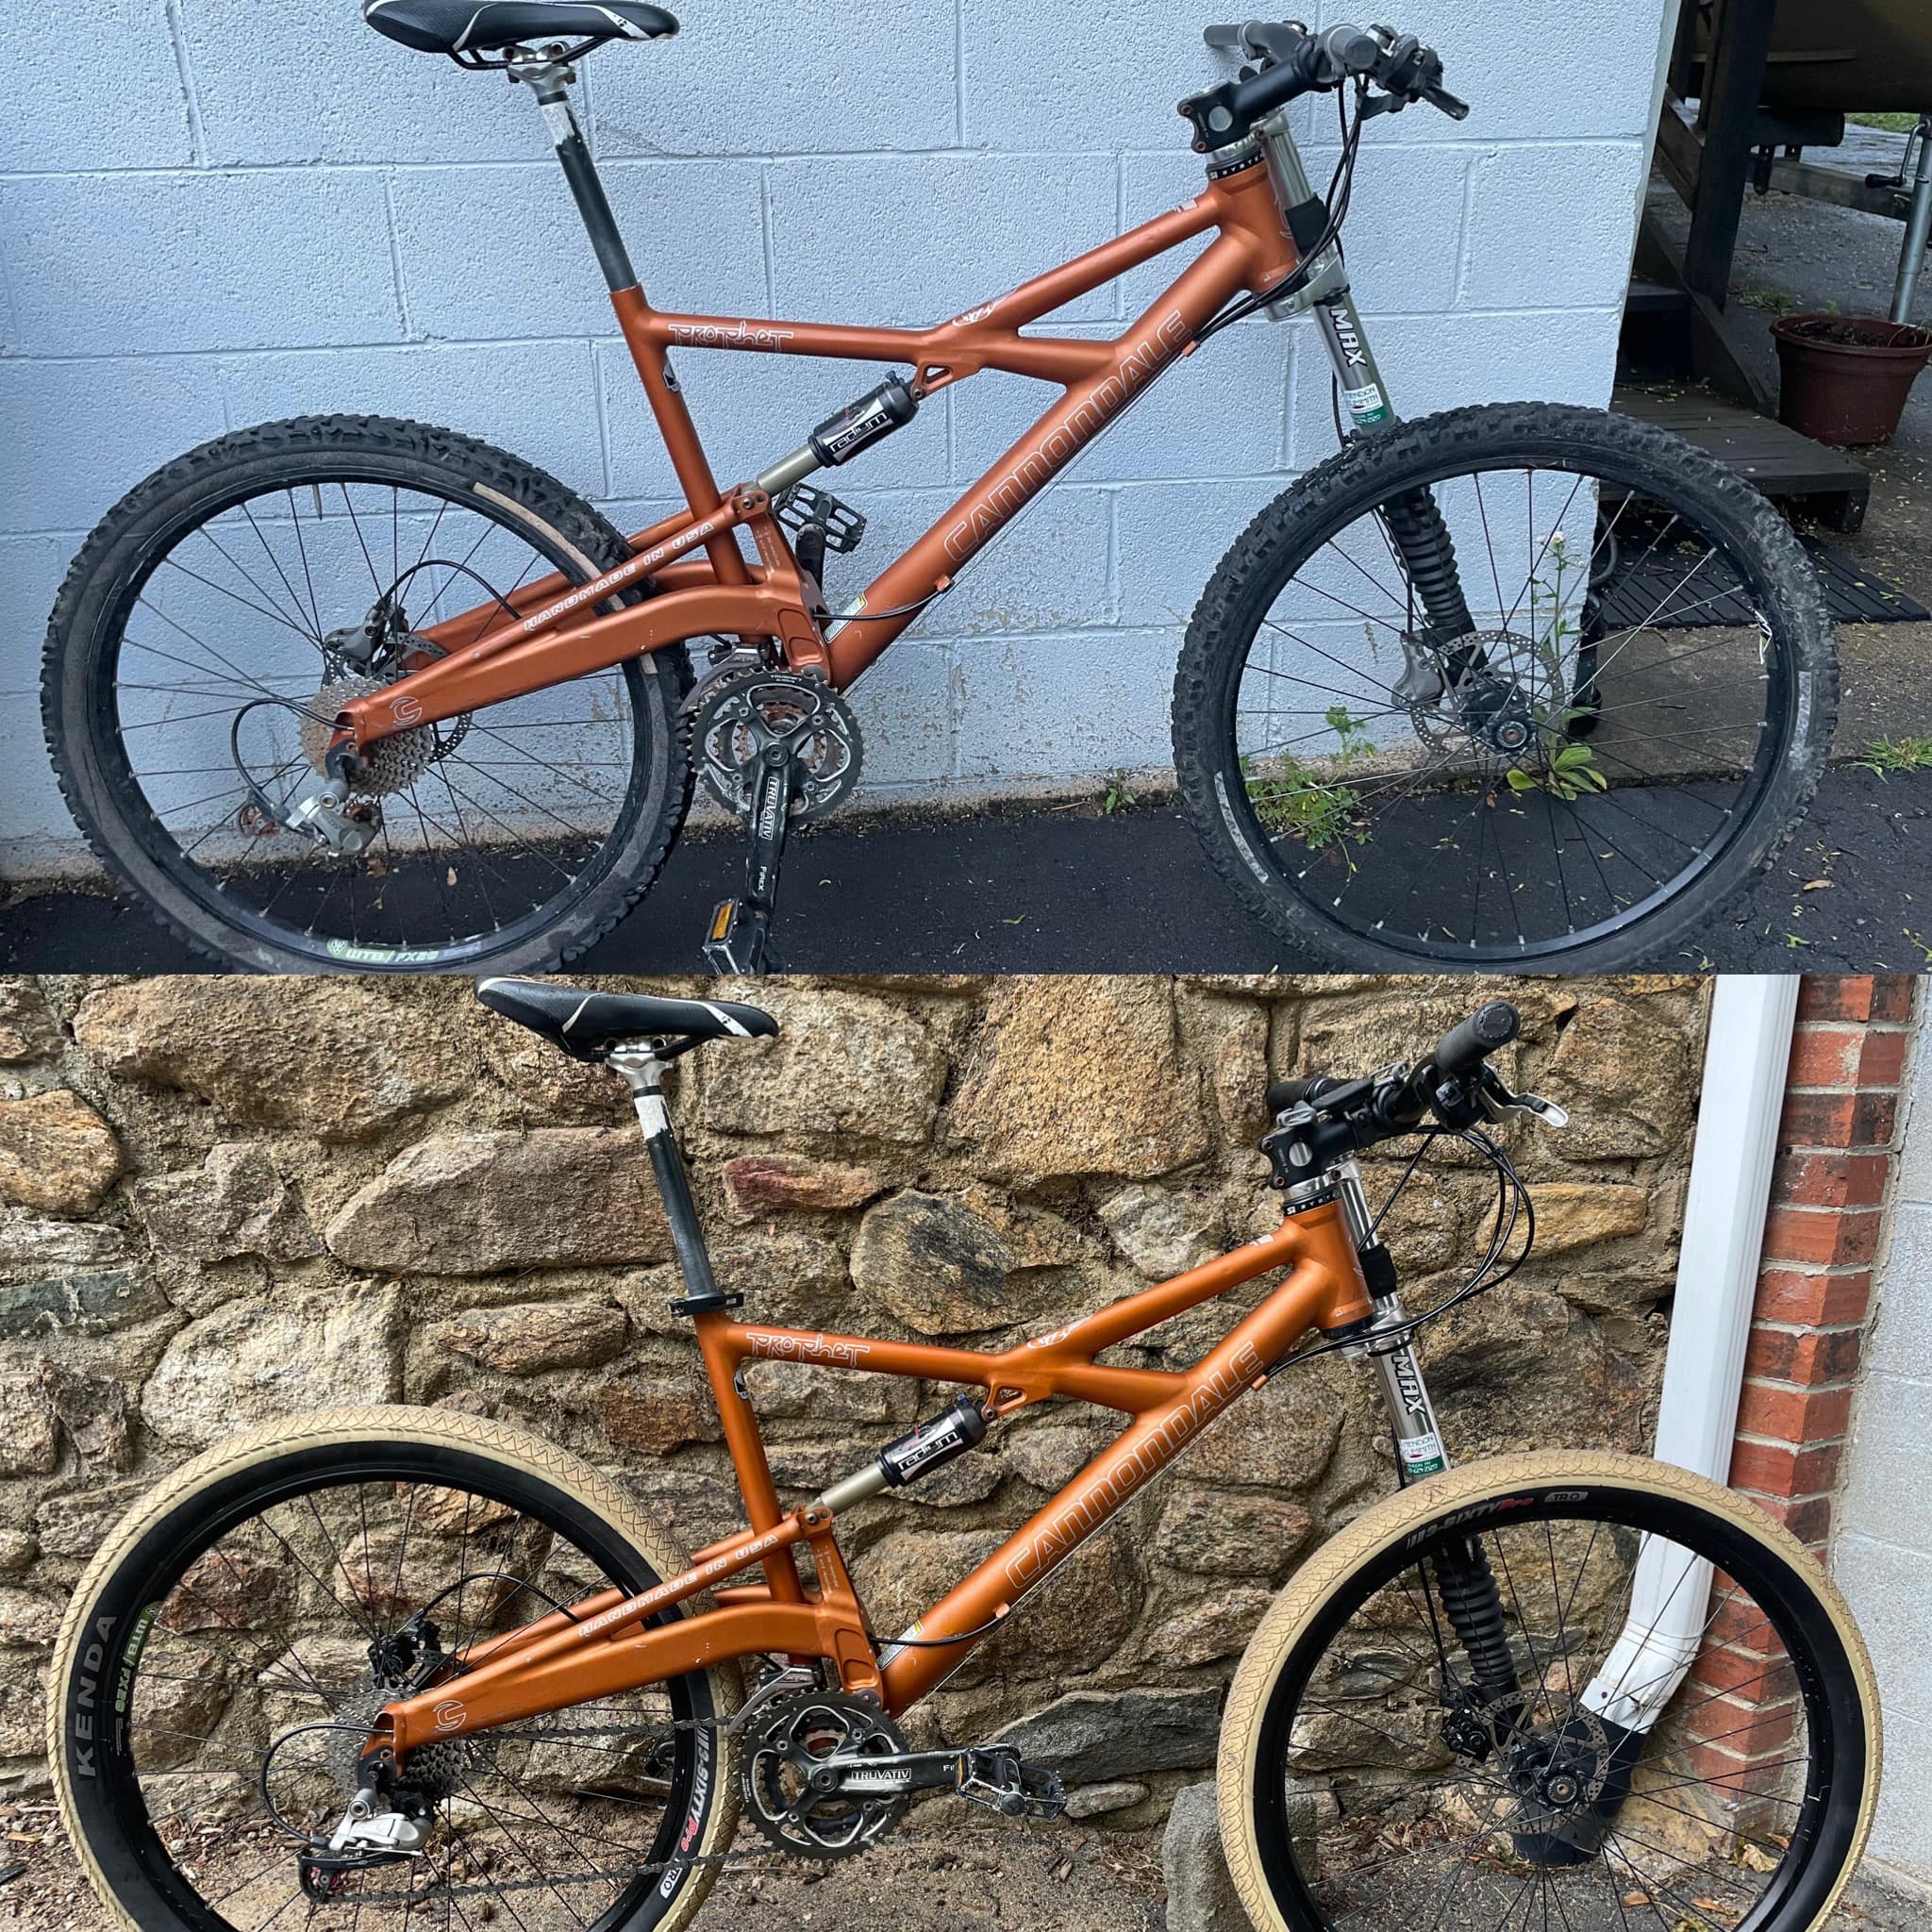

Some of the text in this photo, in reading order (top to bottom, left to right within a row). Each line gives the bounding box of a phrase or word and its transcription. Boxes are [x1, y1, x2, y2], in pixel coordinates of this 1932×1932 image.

[1329, 308, 1367, 367] MAX
[523, 522, 715, 632] HANDMADE IN USA
[761, 778, 778, 840] TRUVATIV
[758, 866, 767, 891] FIREX
[1391, 1356, 1427, 1415] MAX
[578, 1534, 778, 1638] HANDMADE IN USA
[75, 1616, 117, 1777] KENDA
[853, 1768, 911, 1781] TRUVATIV
